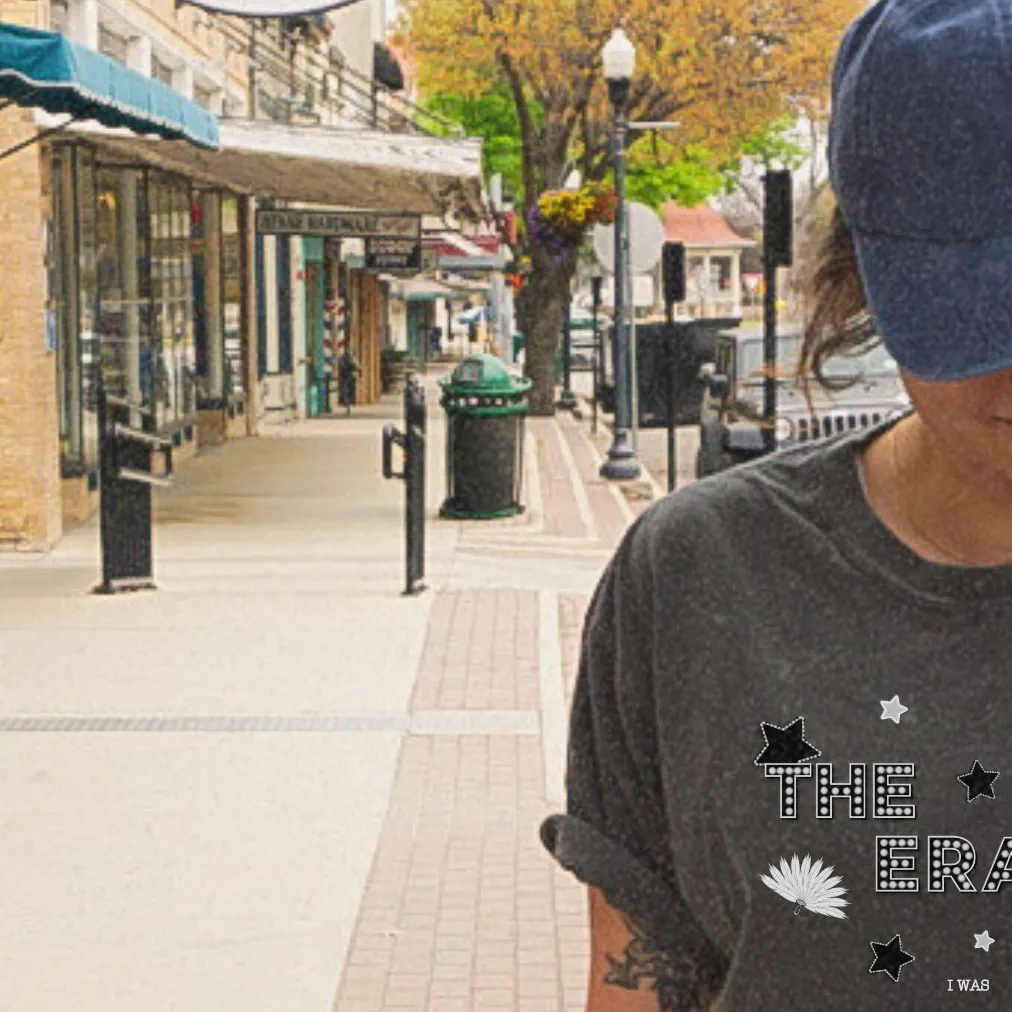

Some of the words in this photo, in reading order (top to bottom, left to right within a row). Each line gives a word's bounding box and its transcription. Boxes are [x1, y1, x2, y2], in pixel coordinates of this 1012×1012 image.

[763, 762, 917, 819] THE
[946, 978, 954, 991] I
[956, 978, 990, 991] WAS
